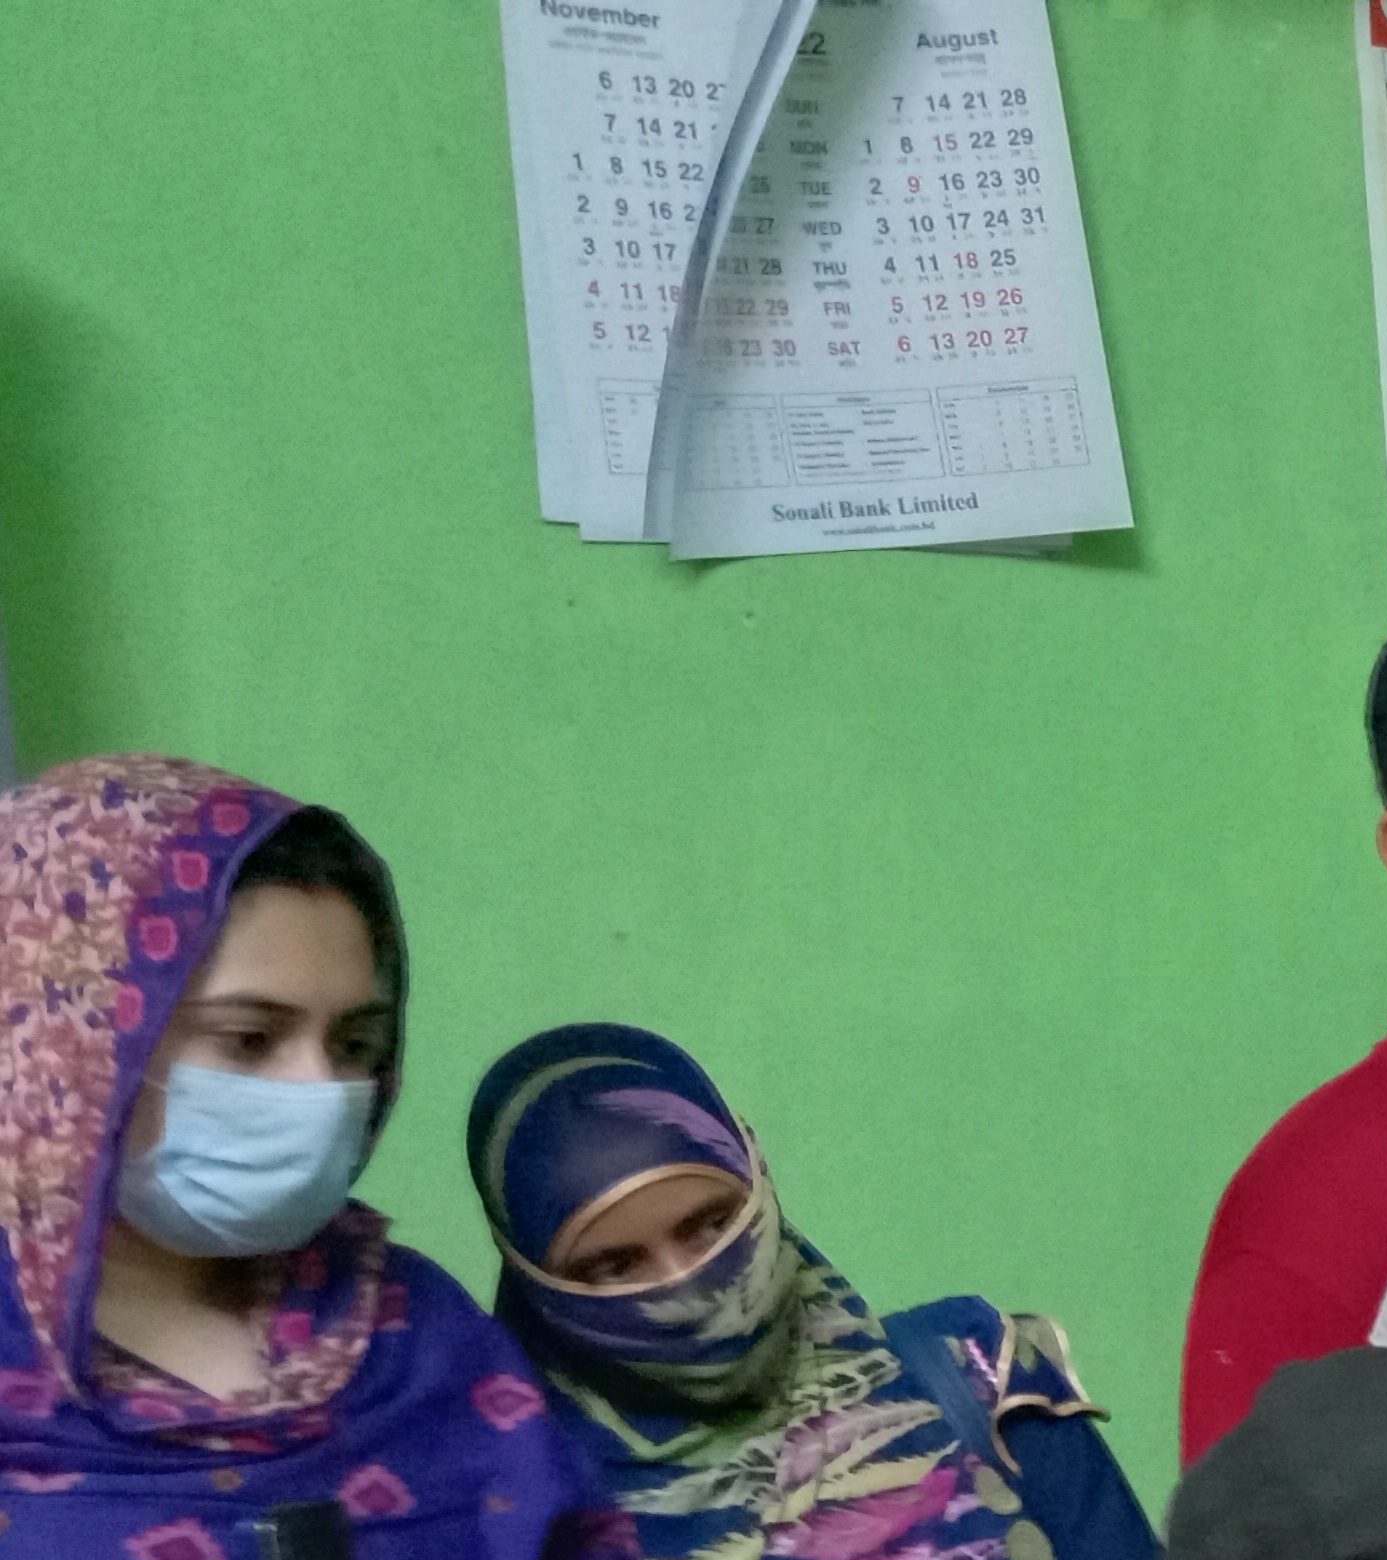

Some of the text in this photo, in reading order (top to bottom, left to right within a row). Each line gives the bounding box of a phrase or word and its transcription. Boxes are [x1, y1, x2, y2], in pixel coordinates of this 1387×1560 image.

[540, 0, 661, 28] November
[916, 28, 998, 51] August
[599, 71, 726, 100] 6 13 20 2
[892, 88, 1027, 112] 7 14 21 28
[604, 113, 698, 140] 7 14 21
[863, 127, 1033, 154] 1 8 15 22 29
[573, 153, 704, 181] 1 8 15 22
[799, 181, 832, 196] TUE
[869, 167, 1040, 195] 2 9 16 23 30
[577, 195, 591, 213] 2
[615, 198, 628, 216] 9
[648, 201, 673, 220] 16
[802, 221, 842, 235] WED
[876, 206, 1045, 234] 3 10 17 24 31
[583, 237, 677, 261] 3 10 17
[761, 258, 782, 275] 28
[812, 261, 847, 275] THU
[884, 249, 1016, 274] 4 11 18 25
[588, 280, 600, 297] 4
[620, 282, 643, 300] 11
[891, 288, 1023, 314] 5 12 19 26
[766, 300, 789, 316] 29
[823, 302, 852, 316] FRI
[593, 322, 606, 339] 5
[626, 324, 652, 342] 12
[898, 327, 1029, 352] 6 13 20 27
[772, 339, 796, 357] 30
[828, 341, 861, 356] SAT
[771, 491, 980, 522] Sonali Bank Limited
